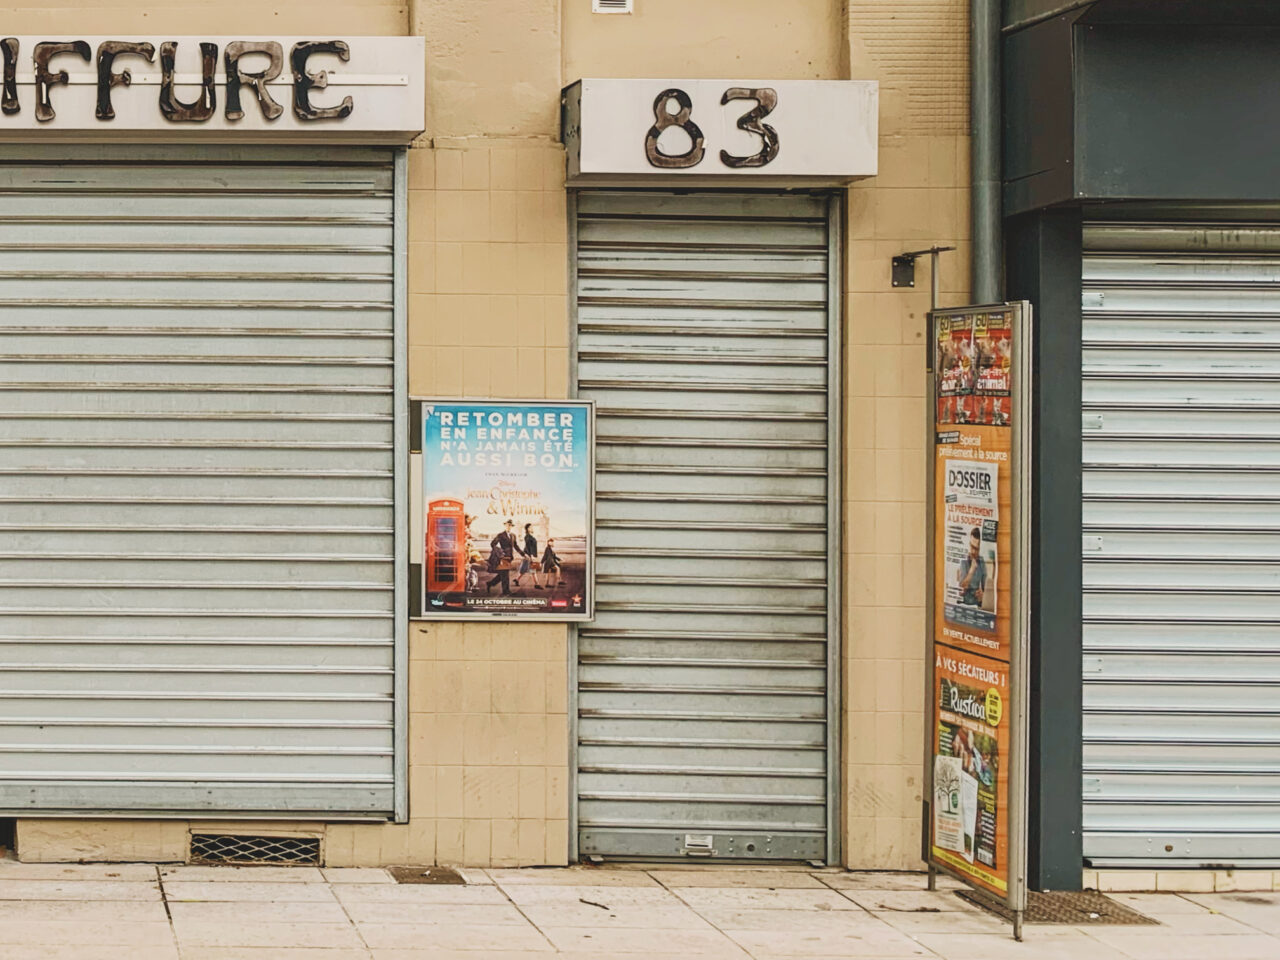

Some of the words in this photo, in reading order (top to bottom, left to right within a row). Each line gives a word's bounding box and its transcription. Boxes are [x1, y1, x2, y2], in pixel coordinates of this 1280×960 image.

[645, 87, 780, 169] 83
[440, 427, 466, 439] EN
[477, 428, 573, 440] ENFANCE
[475, 442, 536, 452] JAMAIS
[544, 440, 573, 452] ÉTÉ
[440, 452, 511, 466] AUSSI
[487, 501, 498, 514] &
[958, 660, 999, 685] SÉCATEURS
[950, 686, 985, 719] Rustica
